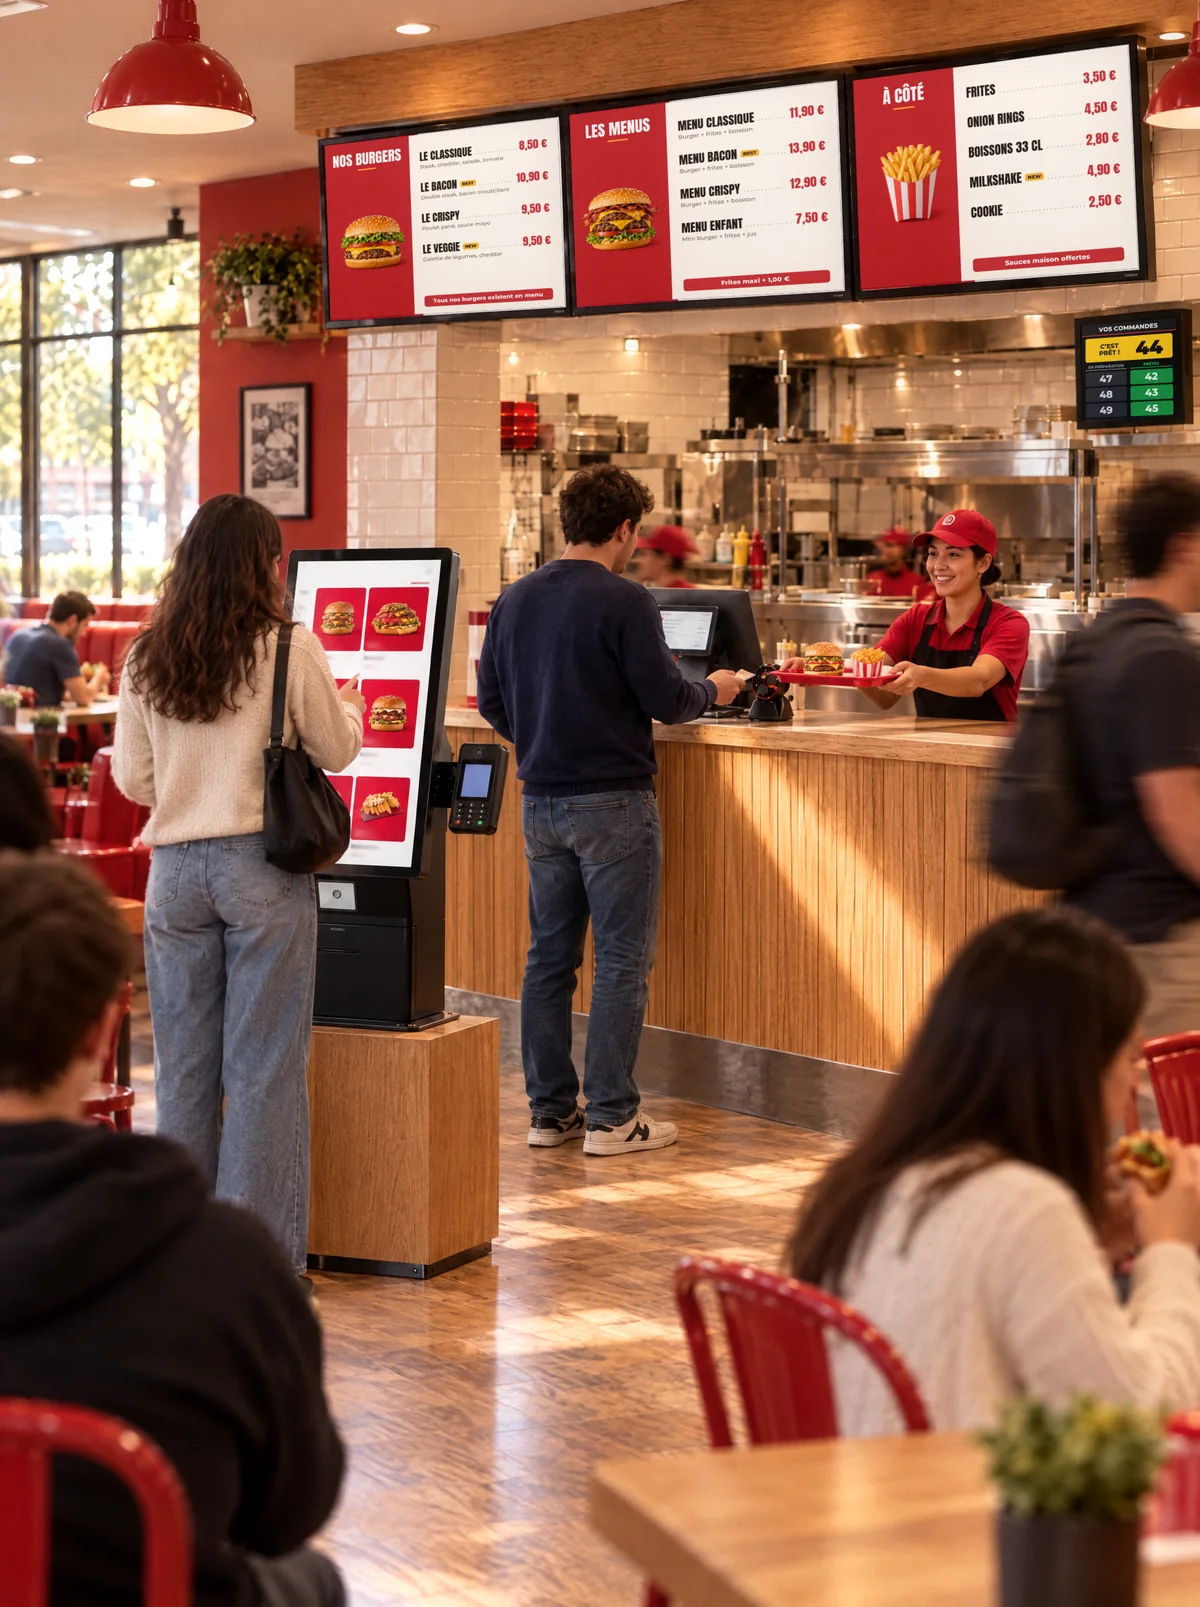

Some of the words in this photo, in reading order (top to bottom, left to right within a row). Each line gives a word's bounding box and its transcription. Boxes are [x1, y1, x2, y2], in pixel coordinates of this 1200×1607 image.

[883, 87, 891, 105] À
[895, 82, 924, 103] CÔTÉ
[966, 84, 996, 98] FRITES
[1083, 70, 1106, 84] 3,50
[1109, 70, 1116, 80] €
[678, 119, 703, 131] MENU
[706, 112, 754, 128] CLASSIQUE
[789, 105, 814, 118] 11,90
[817, 105, 824, 114] €
[967, 114, 994, 128] ONION
[998, 111, 1024, 124] RINGS
[1084, 101, 1107, 115] 4,50
[1110, 101, 1117, 111] €
[585, 123, 605, 138] LES
[609, 118, 650, 136] MENUS
[420, 152, 427, 161] LE
[430, 146, 472, 160] CLASSIQUE
[519, 139, 538, 151] 8,50
[541, 139, 547, 147] €
[679, 153, 704, 165] MENU
[708, 149, 737, 162] BACON
[788, 141, 816, 154] 13,90
[819, 141, 825, 150] €
[969, 142, 1013, 158] BOISSONS
[1016, 141, 1029, 153] 33
[1032, 140, 1043, 151] CL
[1086, 132, 1108, 146] 2,80
[1112, 132, 1119, 142] €
[333, 154, 352, 168] NOS
[356, 149, 401, 165] BURGERS
[421, 182, 429, 192] LE
[432, 180, 457, 191] BACON
[516, 171, 540, 183] 10,90
[542, 171, 548, 179] €
[970, 172, 1022, 188] MILKSHAKE
[1087, 163, 1110, 178] 4,90
[1113, 164, 1120, 173] €
[680, 187, 706, 199] MENU
[709, 183, 740, 196] CRISPY
[790, 176, 816, 189] 12,90
[820, 176, 827, 186] €
[422, 214, 430, 223] LE
[433, 210, 460, 222] CRISPY
[521, 203, 540, 215] 9,50
[544, 203, 550, 212] €
[971, 204, 1003, 218] COOKIE
[1088, 195, 1112, 208] 2,50
[1115, 195, 1122, 205] €
[682, 221, 707, 233] MENU
[710, 218, 743, 230] ENFANT
[796, 212, 818, 225] 7,50
[821, 212, 828, 221] €
[423, 244, 431, 254] LE
[434, 242, 460, 253] VEGGIE
[522, 236, 542, 247] 9,50
[545, 236, 551, 244] €
[452, 253, 478, 261] légumes,
[1114, 323, 1158, 331] COMMANDES
[1136, 340, 1163, 354] 44
